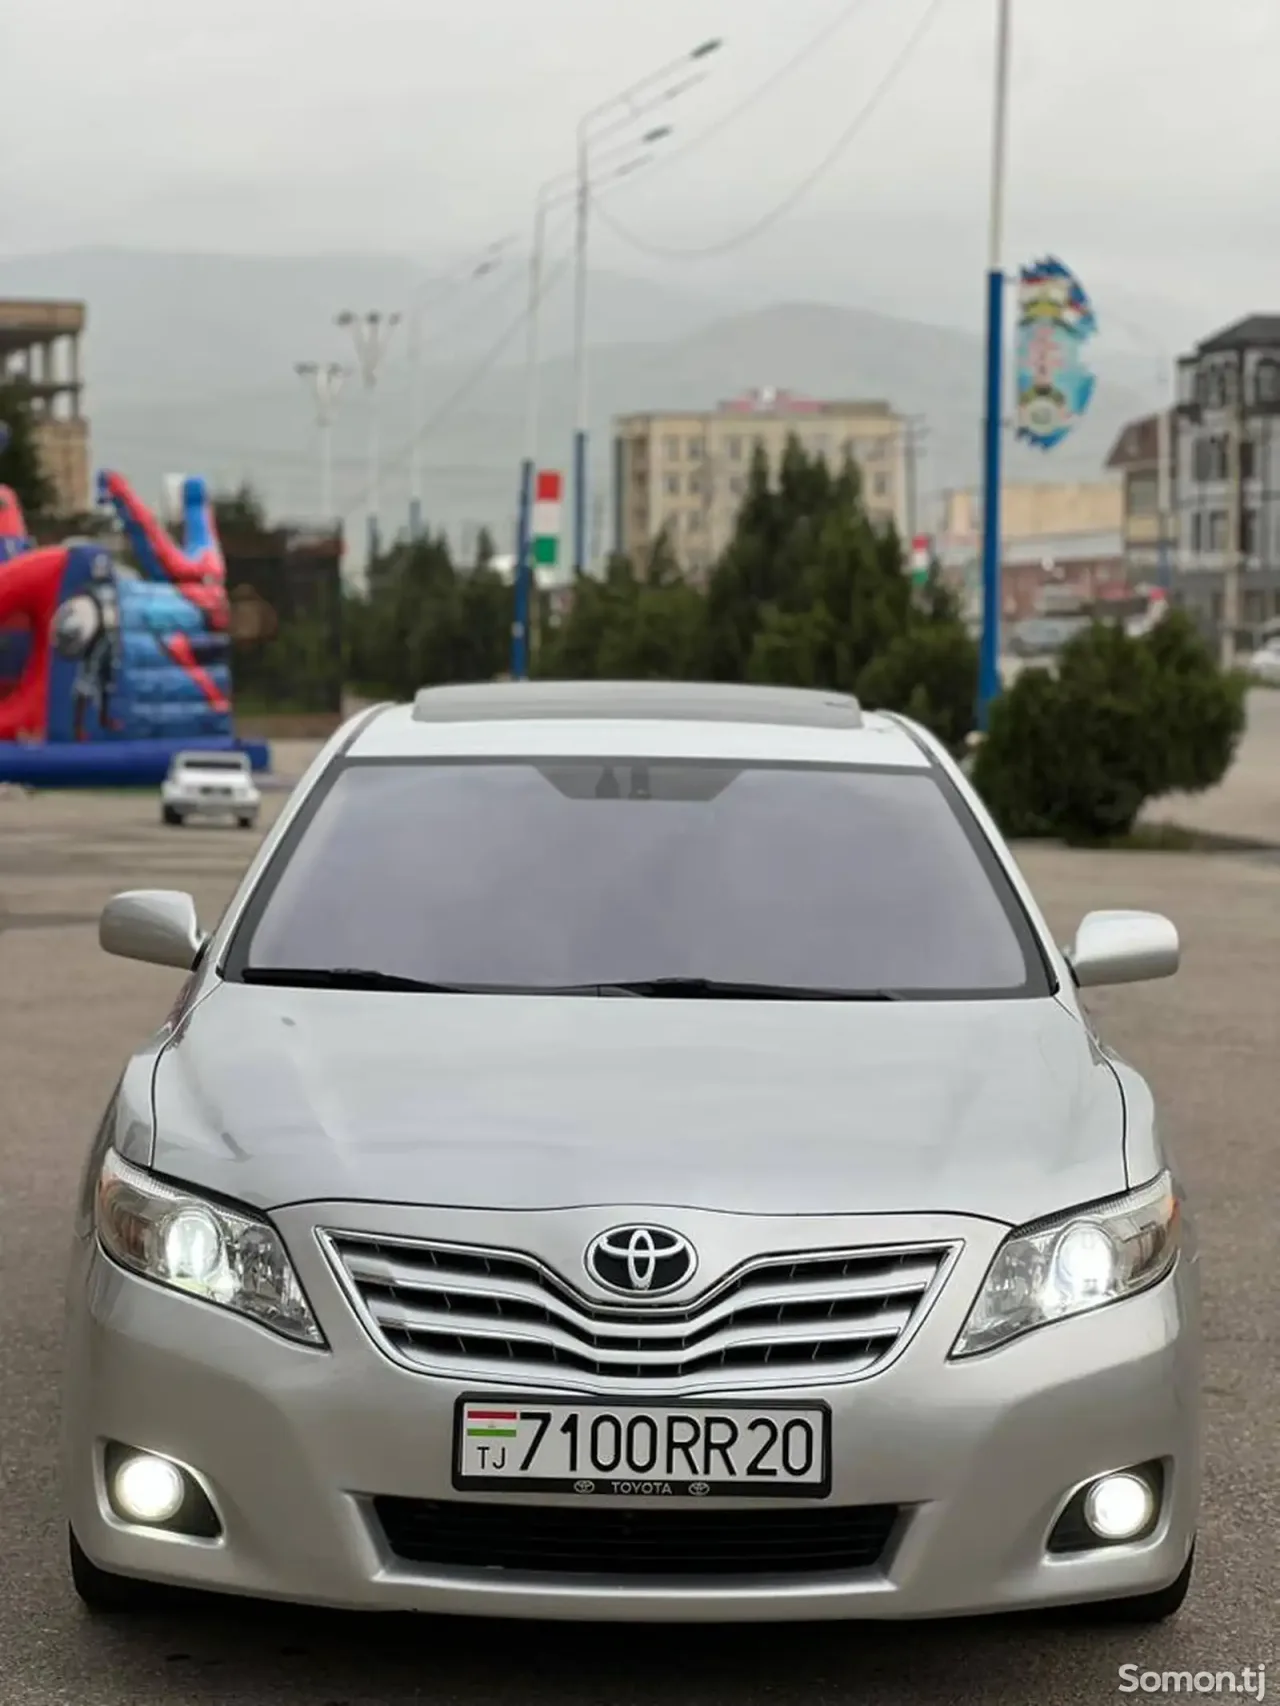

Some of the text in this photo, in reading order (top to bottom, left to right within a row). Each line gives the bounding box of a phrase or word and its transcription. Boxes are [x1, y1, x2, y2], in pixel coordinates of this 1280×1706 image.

[519, 1411, 814, 1476] 7100RR20
[477, 1446, 506, 1469] TJ
[611, 1481, 672, 1495] TOYOTA
